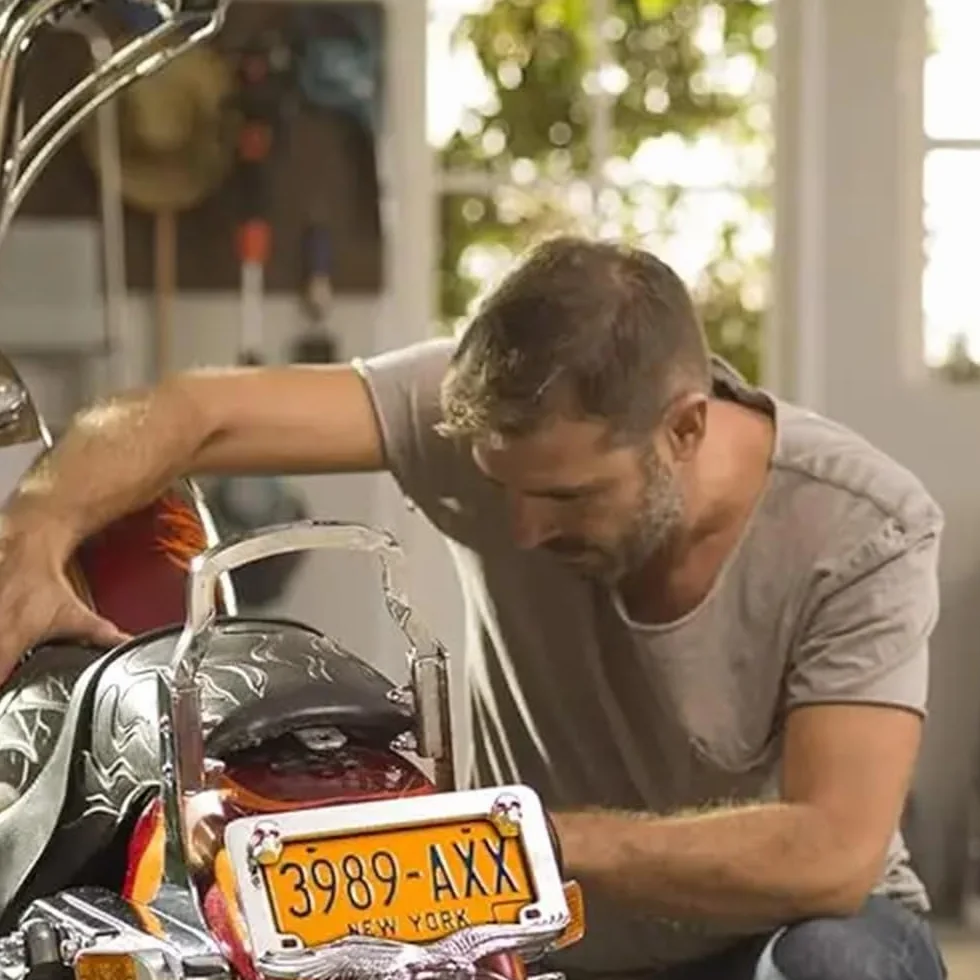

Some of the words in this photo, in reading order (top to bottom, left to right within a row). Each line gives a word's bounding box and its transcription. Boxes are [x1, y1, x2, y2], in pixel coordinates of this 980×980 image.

[280, 837, 519, 918] 3989-AXX
[347, 917, 396, 937] NEW
[407, 908, 470, 932] YORK
